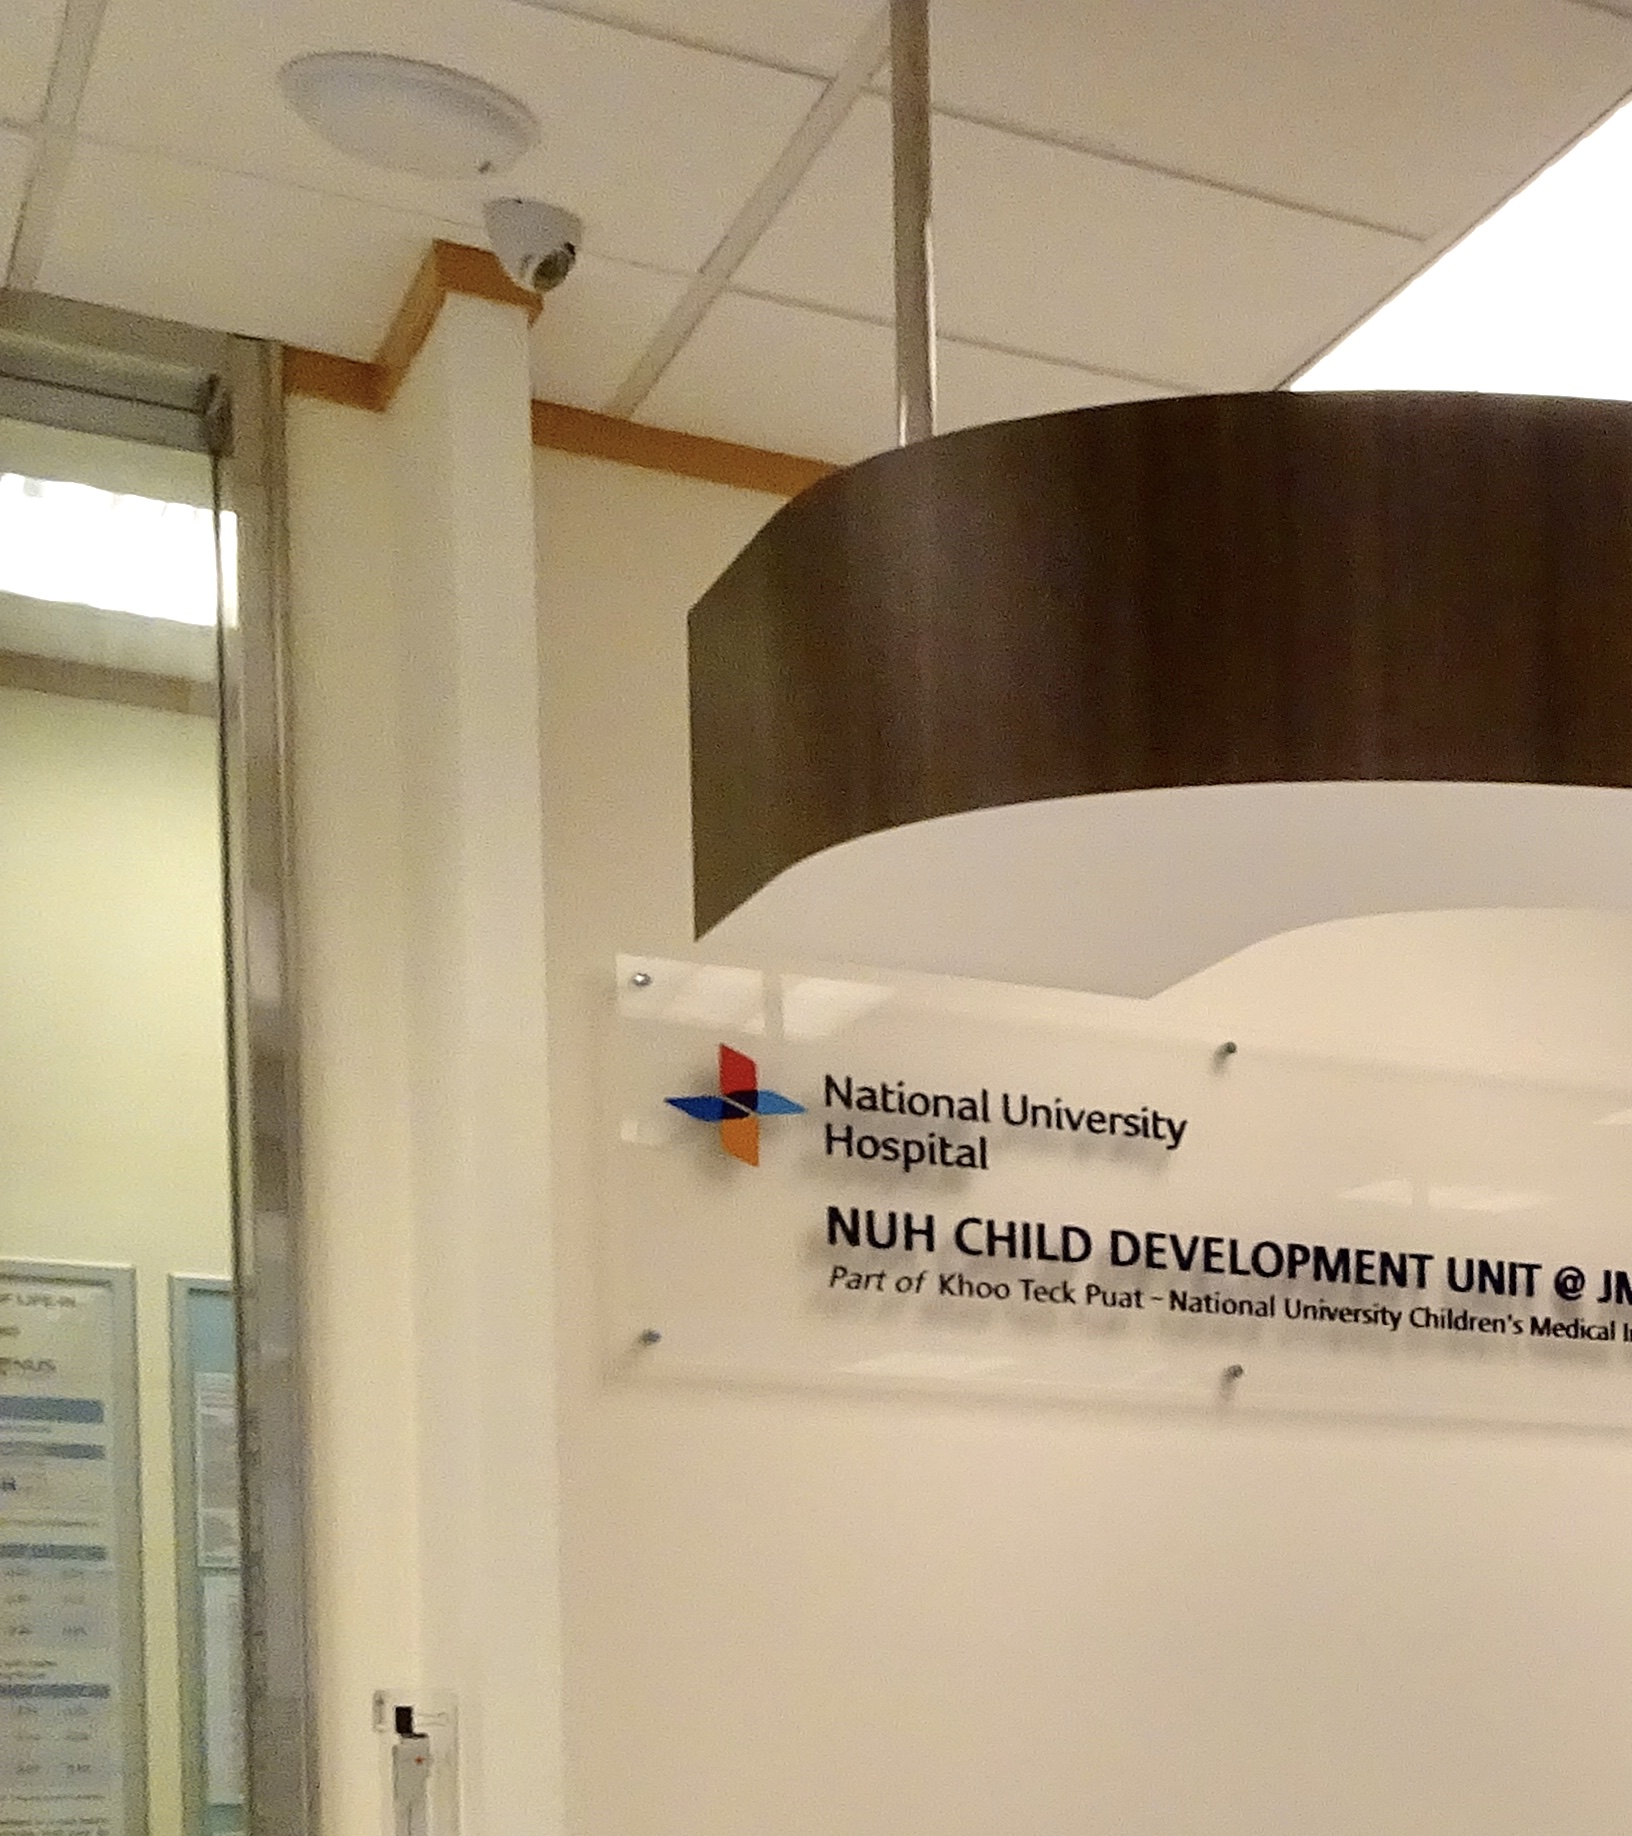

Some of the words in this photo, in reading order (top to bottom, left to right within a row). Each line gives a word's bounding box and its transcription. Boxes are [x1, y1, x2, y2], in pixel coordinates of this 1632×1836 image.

[825, 1074, 990, 1123] National
[1002, 1093, 1188, 1150] University
[825, 1123, 988, 1172] Hospital
[827, 1205, 935, 1252] NUH
[954, 1217, 1093, 1263] CHILD
[1110, 1229, 1434, 1289] DEVELOPMENT
[1447, 1256, 1542, 1298] UNIT
[1554, 1266, 1585, 1301] @
[829, 1265, 885, 1291] Part
[895, 1271, 929, 1295] of
[939, 1273, 1010, 1300] Khoo
[1019, 1278, 1076, 1305] Teck
[1086, 1283, 1144, 1310] Puat
[1169, 1289, 1276, 1319] National
[1284, 1297, 1403, 1332] University
[1409, 1306, 1523, 1335] Children's
[1530, 1315, 1616, 1342] Medical
